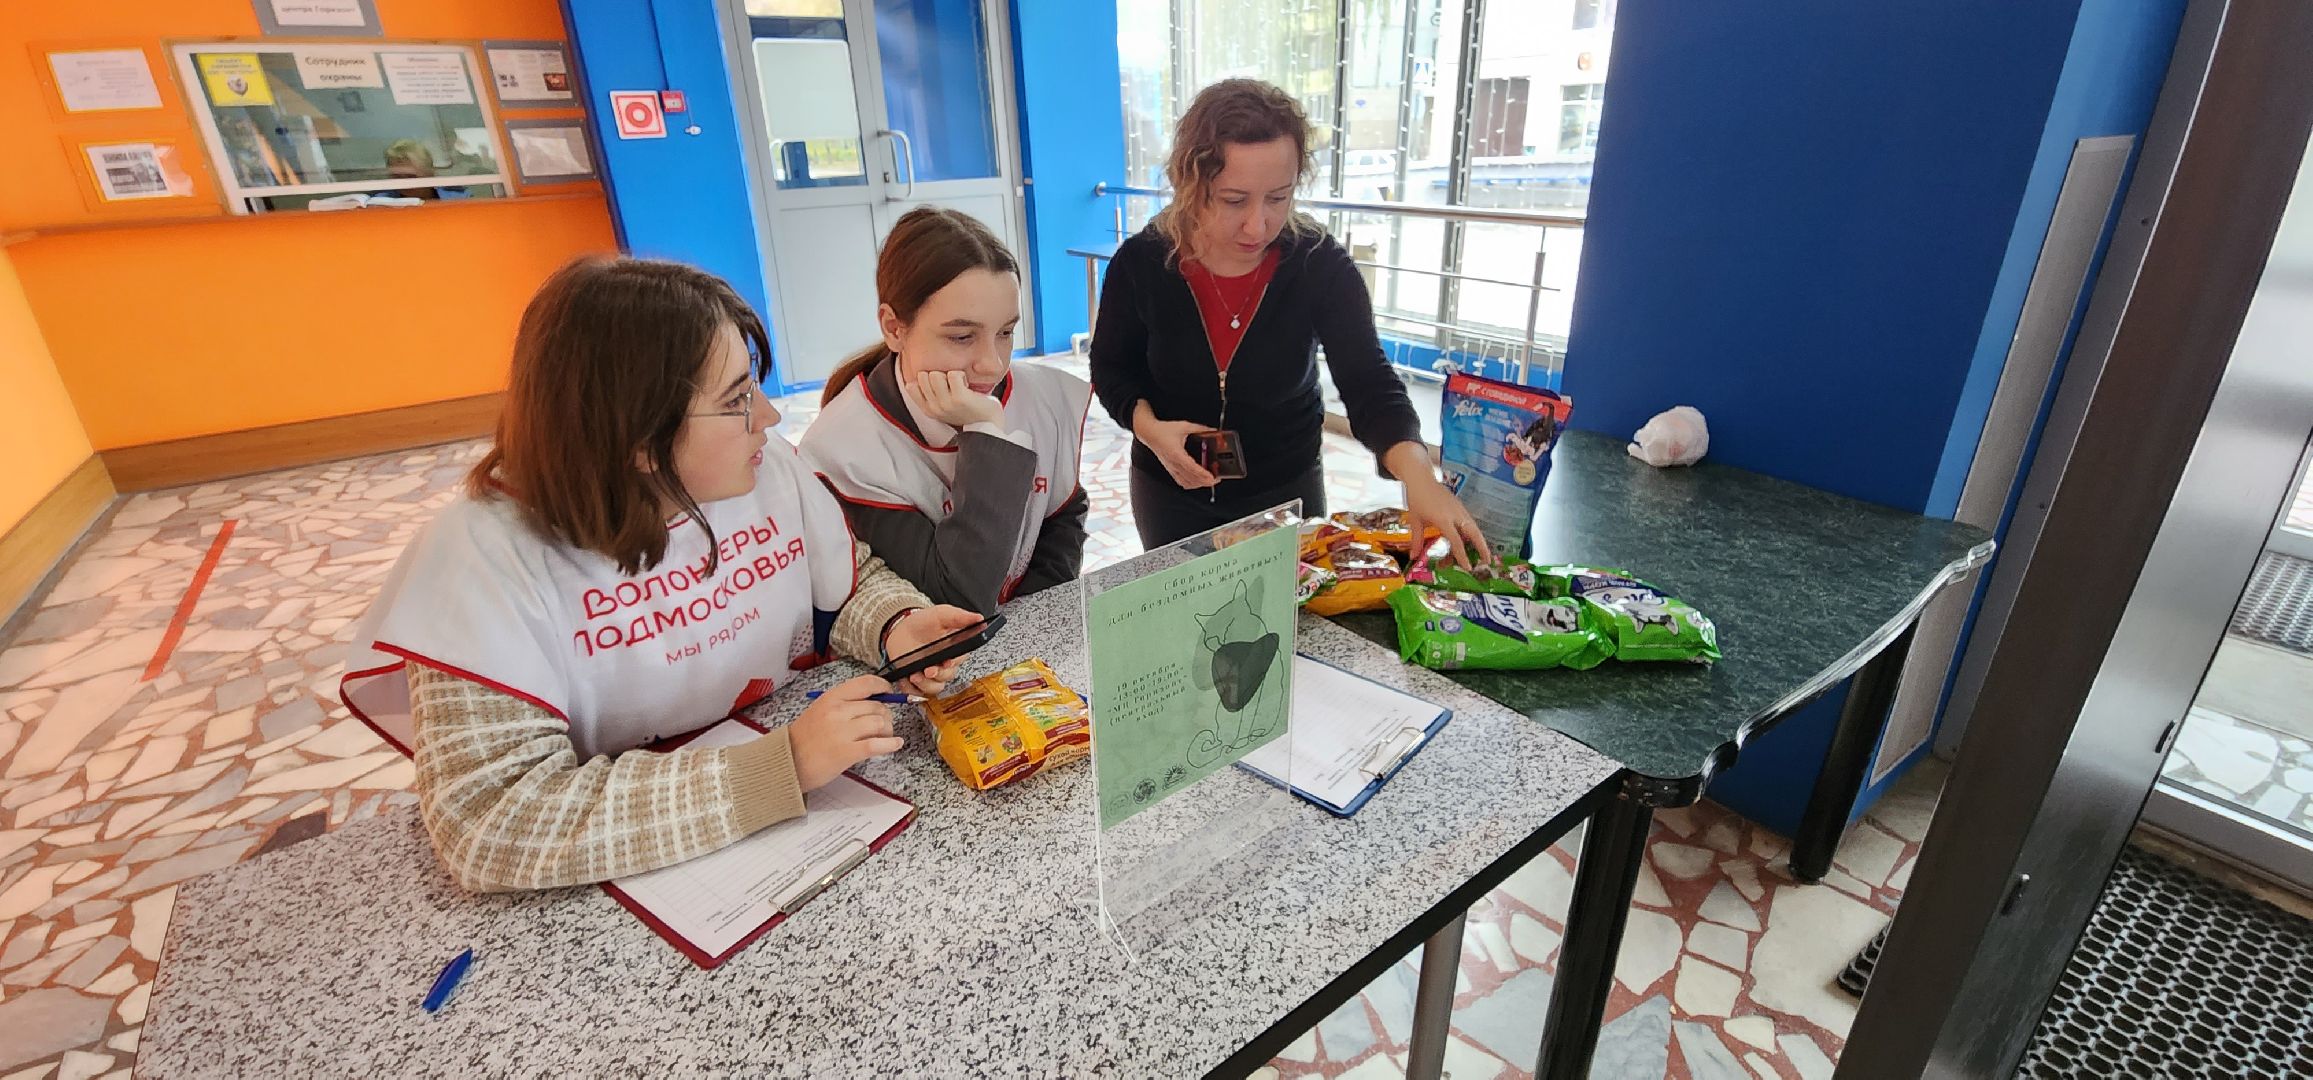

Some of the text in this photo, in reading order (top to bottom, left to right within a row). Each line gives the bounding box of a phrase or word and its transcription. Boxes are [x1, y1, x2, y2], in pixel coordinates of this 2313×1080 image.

[305, 56, 367, 66] Сотрудник
[320, 74, 362, 83] охраны
[583, 516, 780, 620] ВОЛОНЕРЫ
[1164, 558, 1239, 591] Сбор корма
[573, 537, 805, 657] ПОДМОСКОВЬЯ
[1140, 581, 1214, 613] бездомных
[666, 642, 701, 666] МЫ
[1117, 663, 1176, 692] 19 октября
